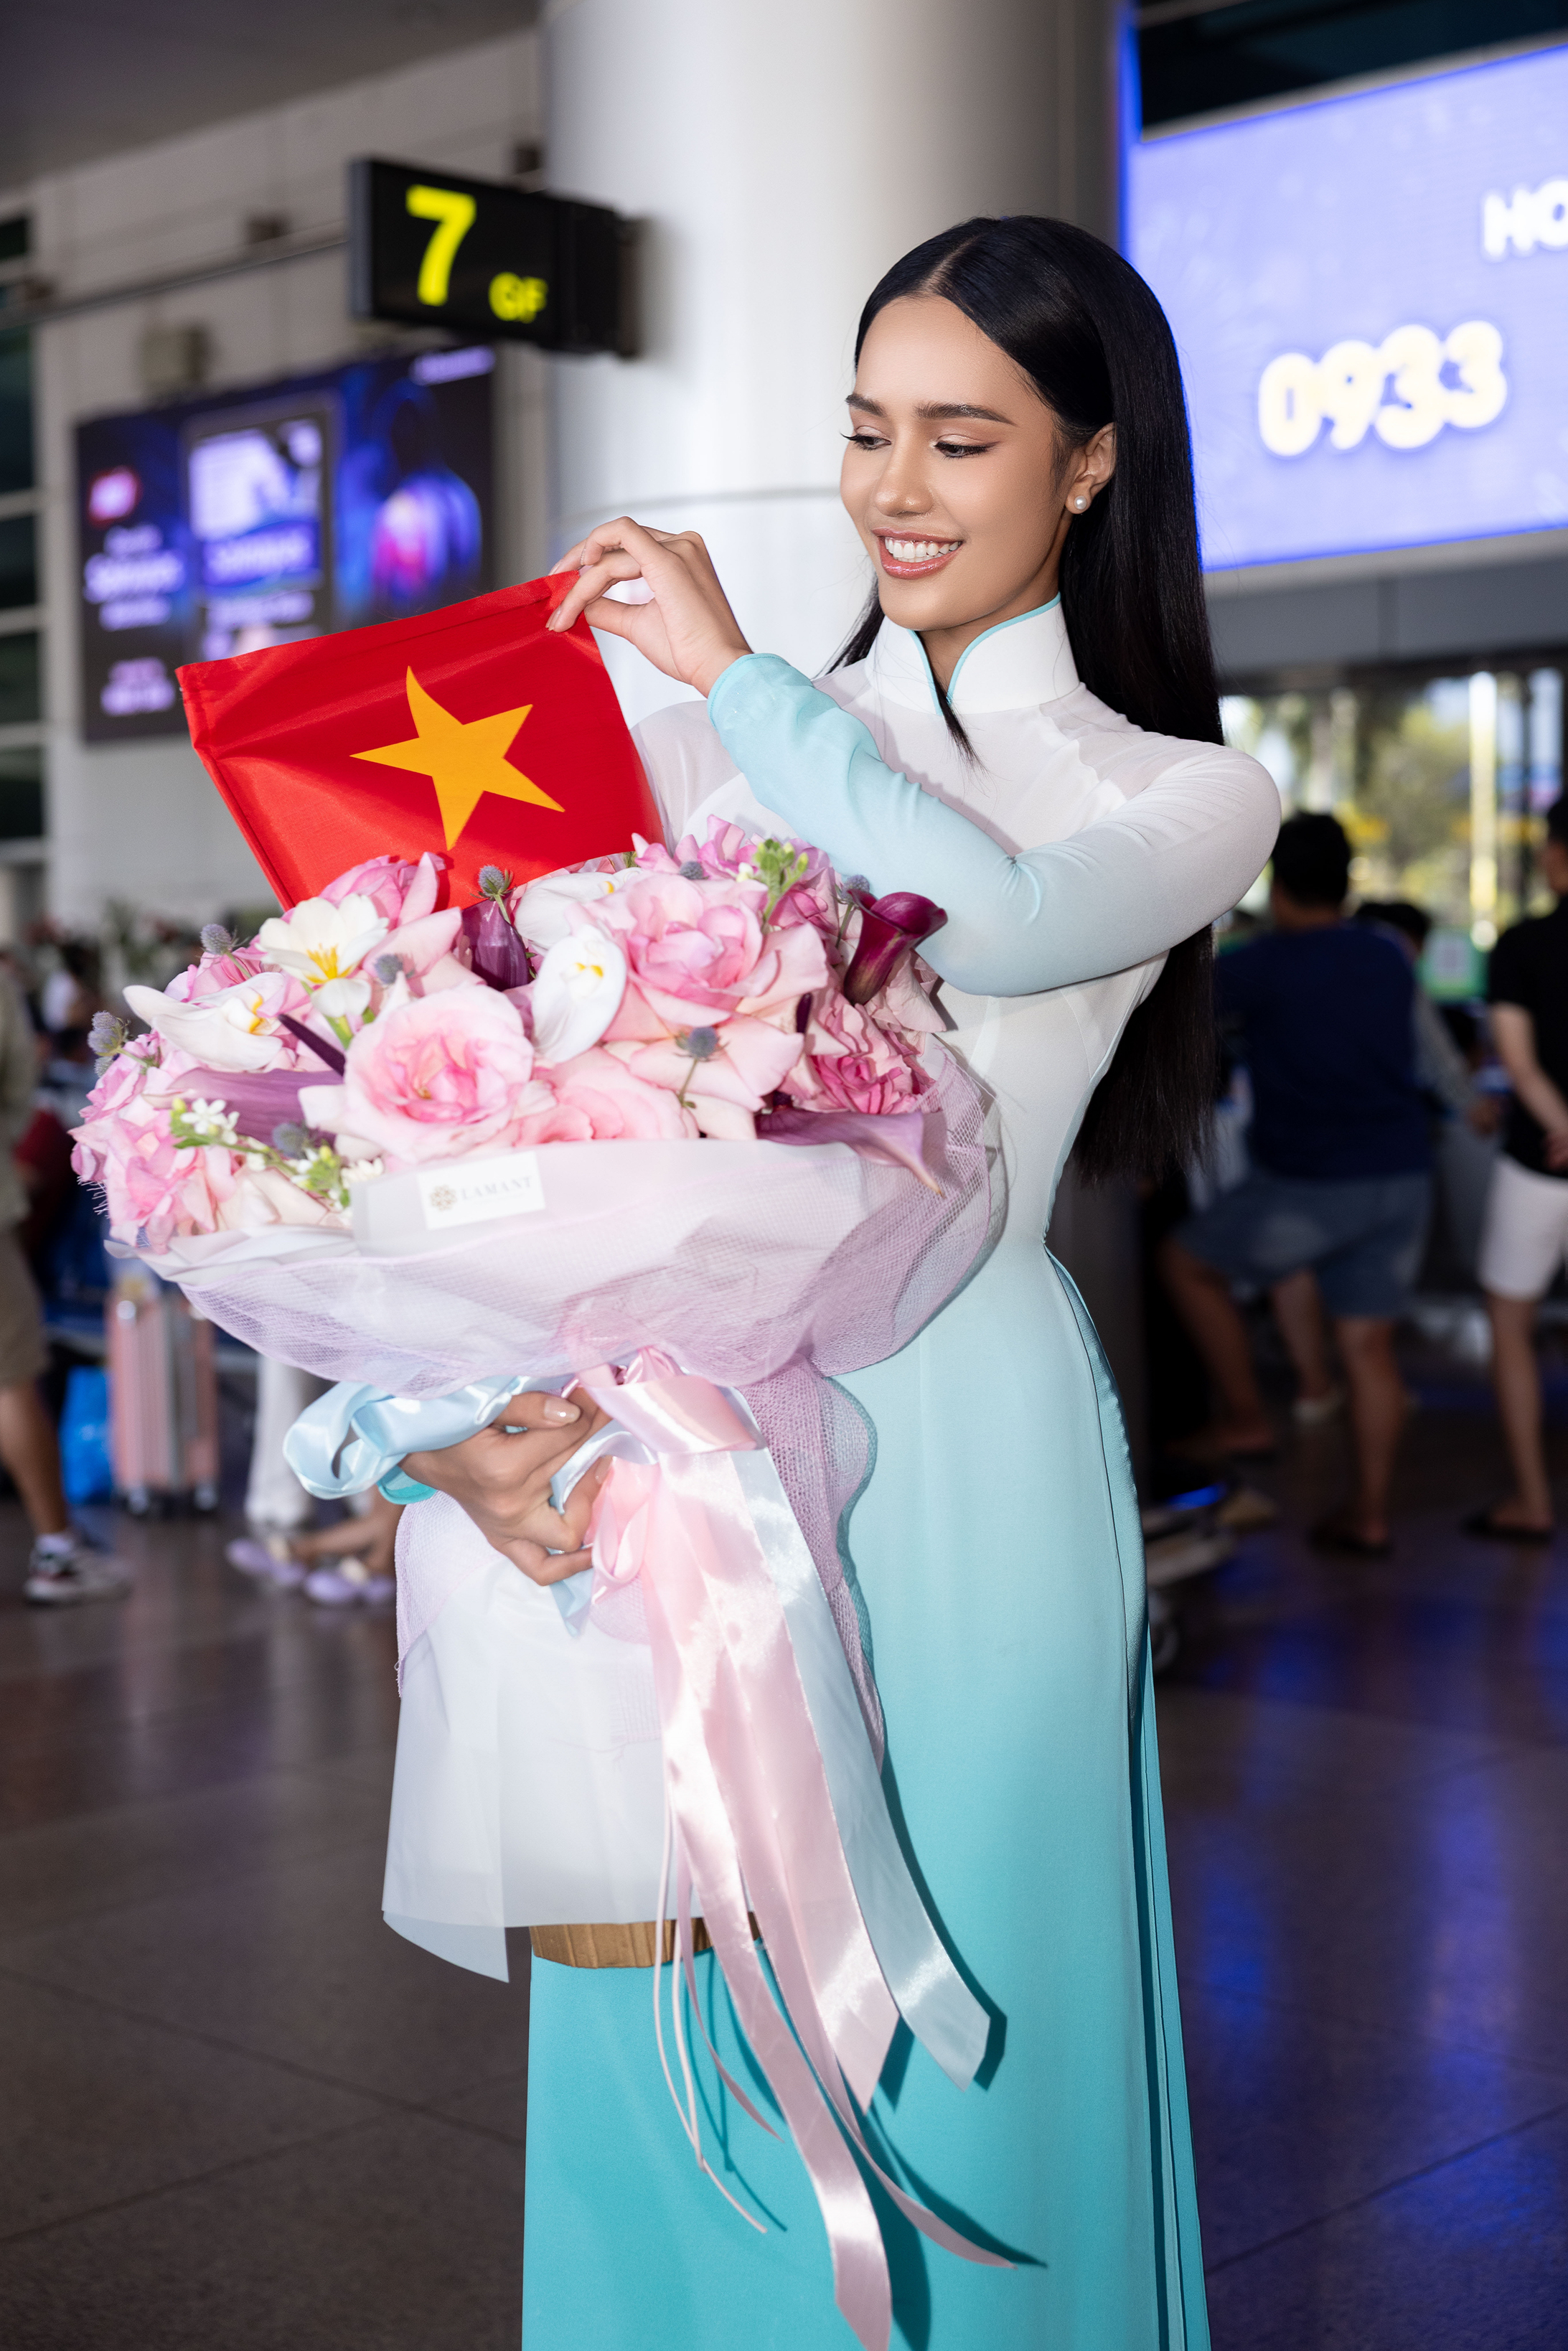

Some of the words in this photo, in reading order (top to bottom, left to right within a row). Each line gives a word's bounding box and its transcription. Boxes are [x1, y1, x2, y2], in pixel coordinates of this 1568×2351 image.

[406, 184, 476, 306] 7
[1259, 320, 1508, 456] 0933
[461, 1177, 531, 1200] LAMANT
